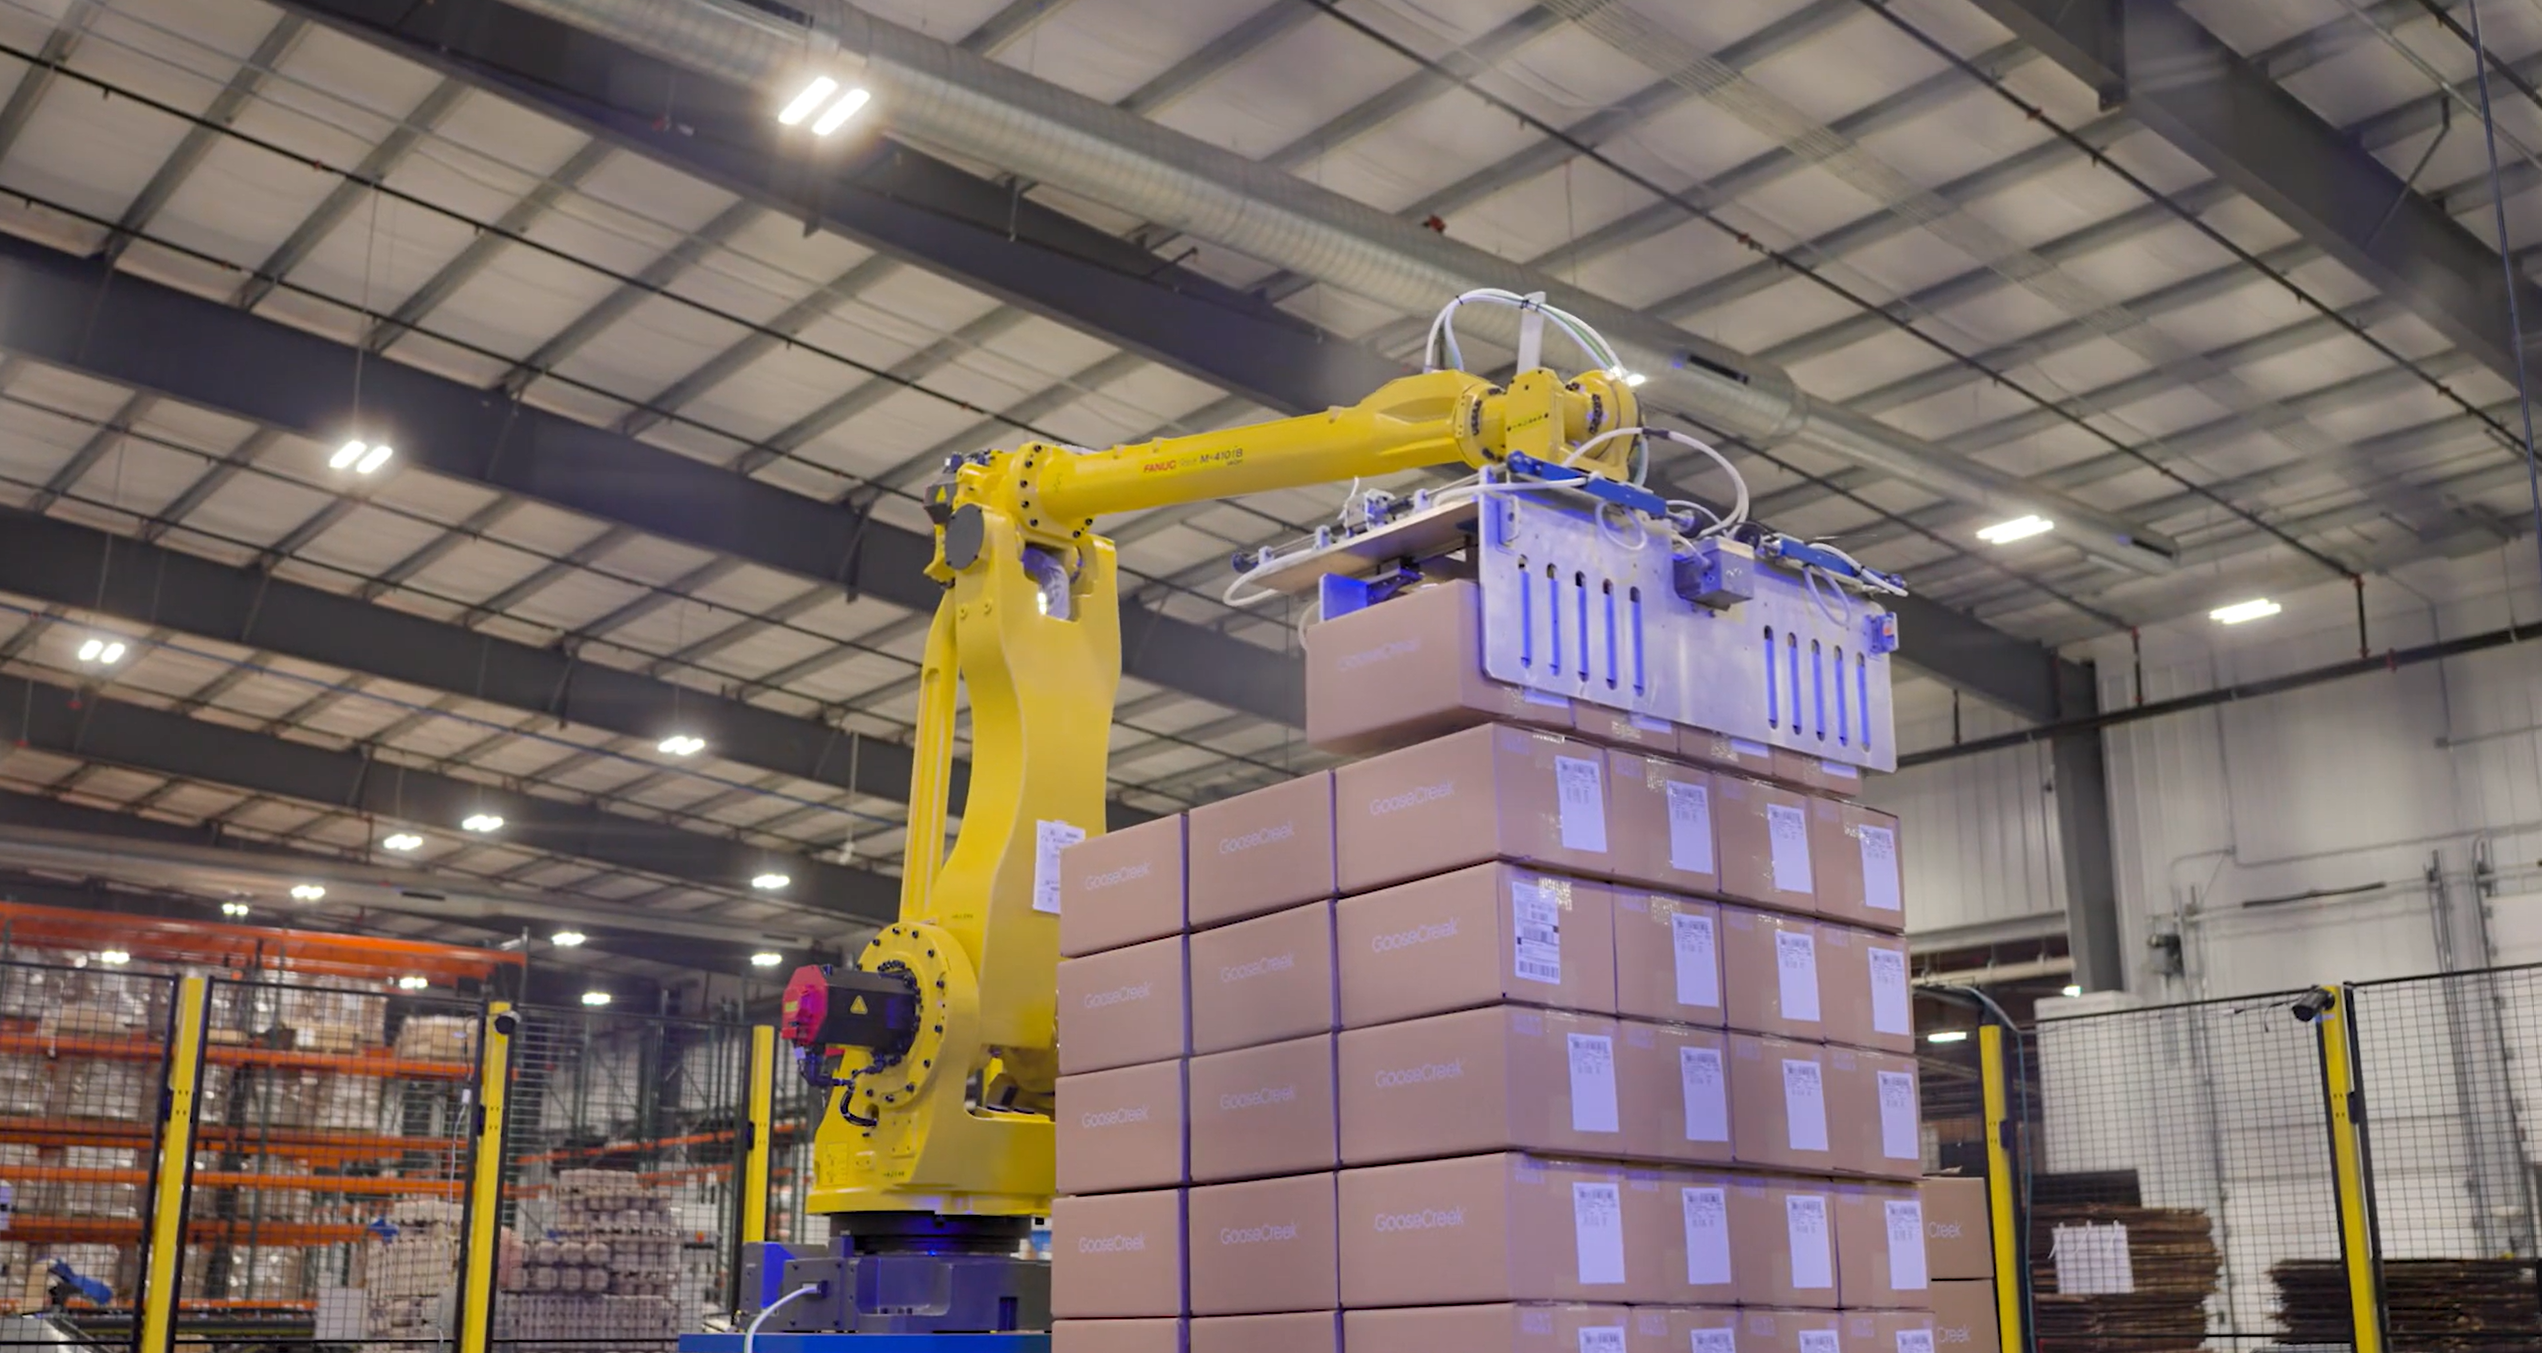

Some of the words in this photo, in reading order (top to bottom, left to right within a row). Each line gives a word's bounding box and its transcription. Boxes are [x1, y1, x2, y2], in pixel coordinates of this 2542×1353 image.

[1143, 460, 1176, 473] FANUC
[1371, 781, 1456, 817] GooseCreek
[1220, 821, 1295, 855] GooseCreek
[1086, 862, 1151, 892] GooseCreek
[1372, 918, 1459, 954] GooseCreek
[1220, 953, 1295, 982] GooseCreek
[1084, 983, 1151, 1010] GooseCreek
[1375, 1059, 1465, 1088] GooseCreek
[1220, 1086, 1297, 1110] GooseCreek
[1082, 1105, 1150, 1129] GooseCreek
[1220, 1221, 1298, 1245] GooseCreek
[1374, 1206, 1466, 1233] GooseCreek
[1078, 1234, 1147, 1254] GooseCreek
